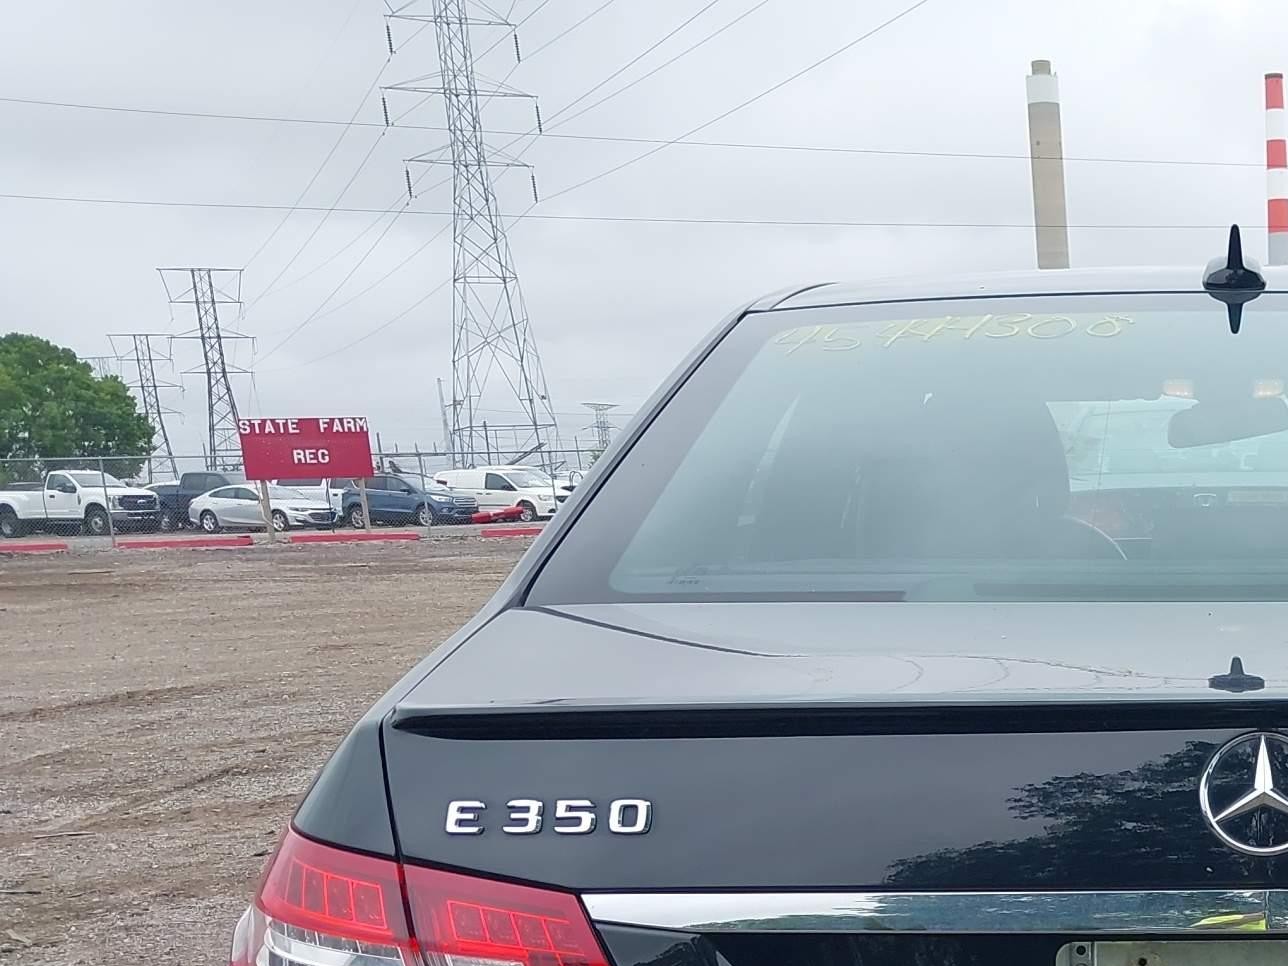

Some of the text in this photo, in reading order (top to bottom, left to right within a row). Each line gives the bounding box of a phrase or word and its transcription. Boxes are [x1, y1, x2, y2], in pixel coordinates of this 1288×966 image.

[239, 418, 368, 434] STATE FARM
[293, 449, 330, 464] REG
[445, 799, 653, 835] E 350
